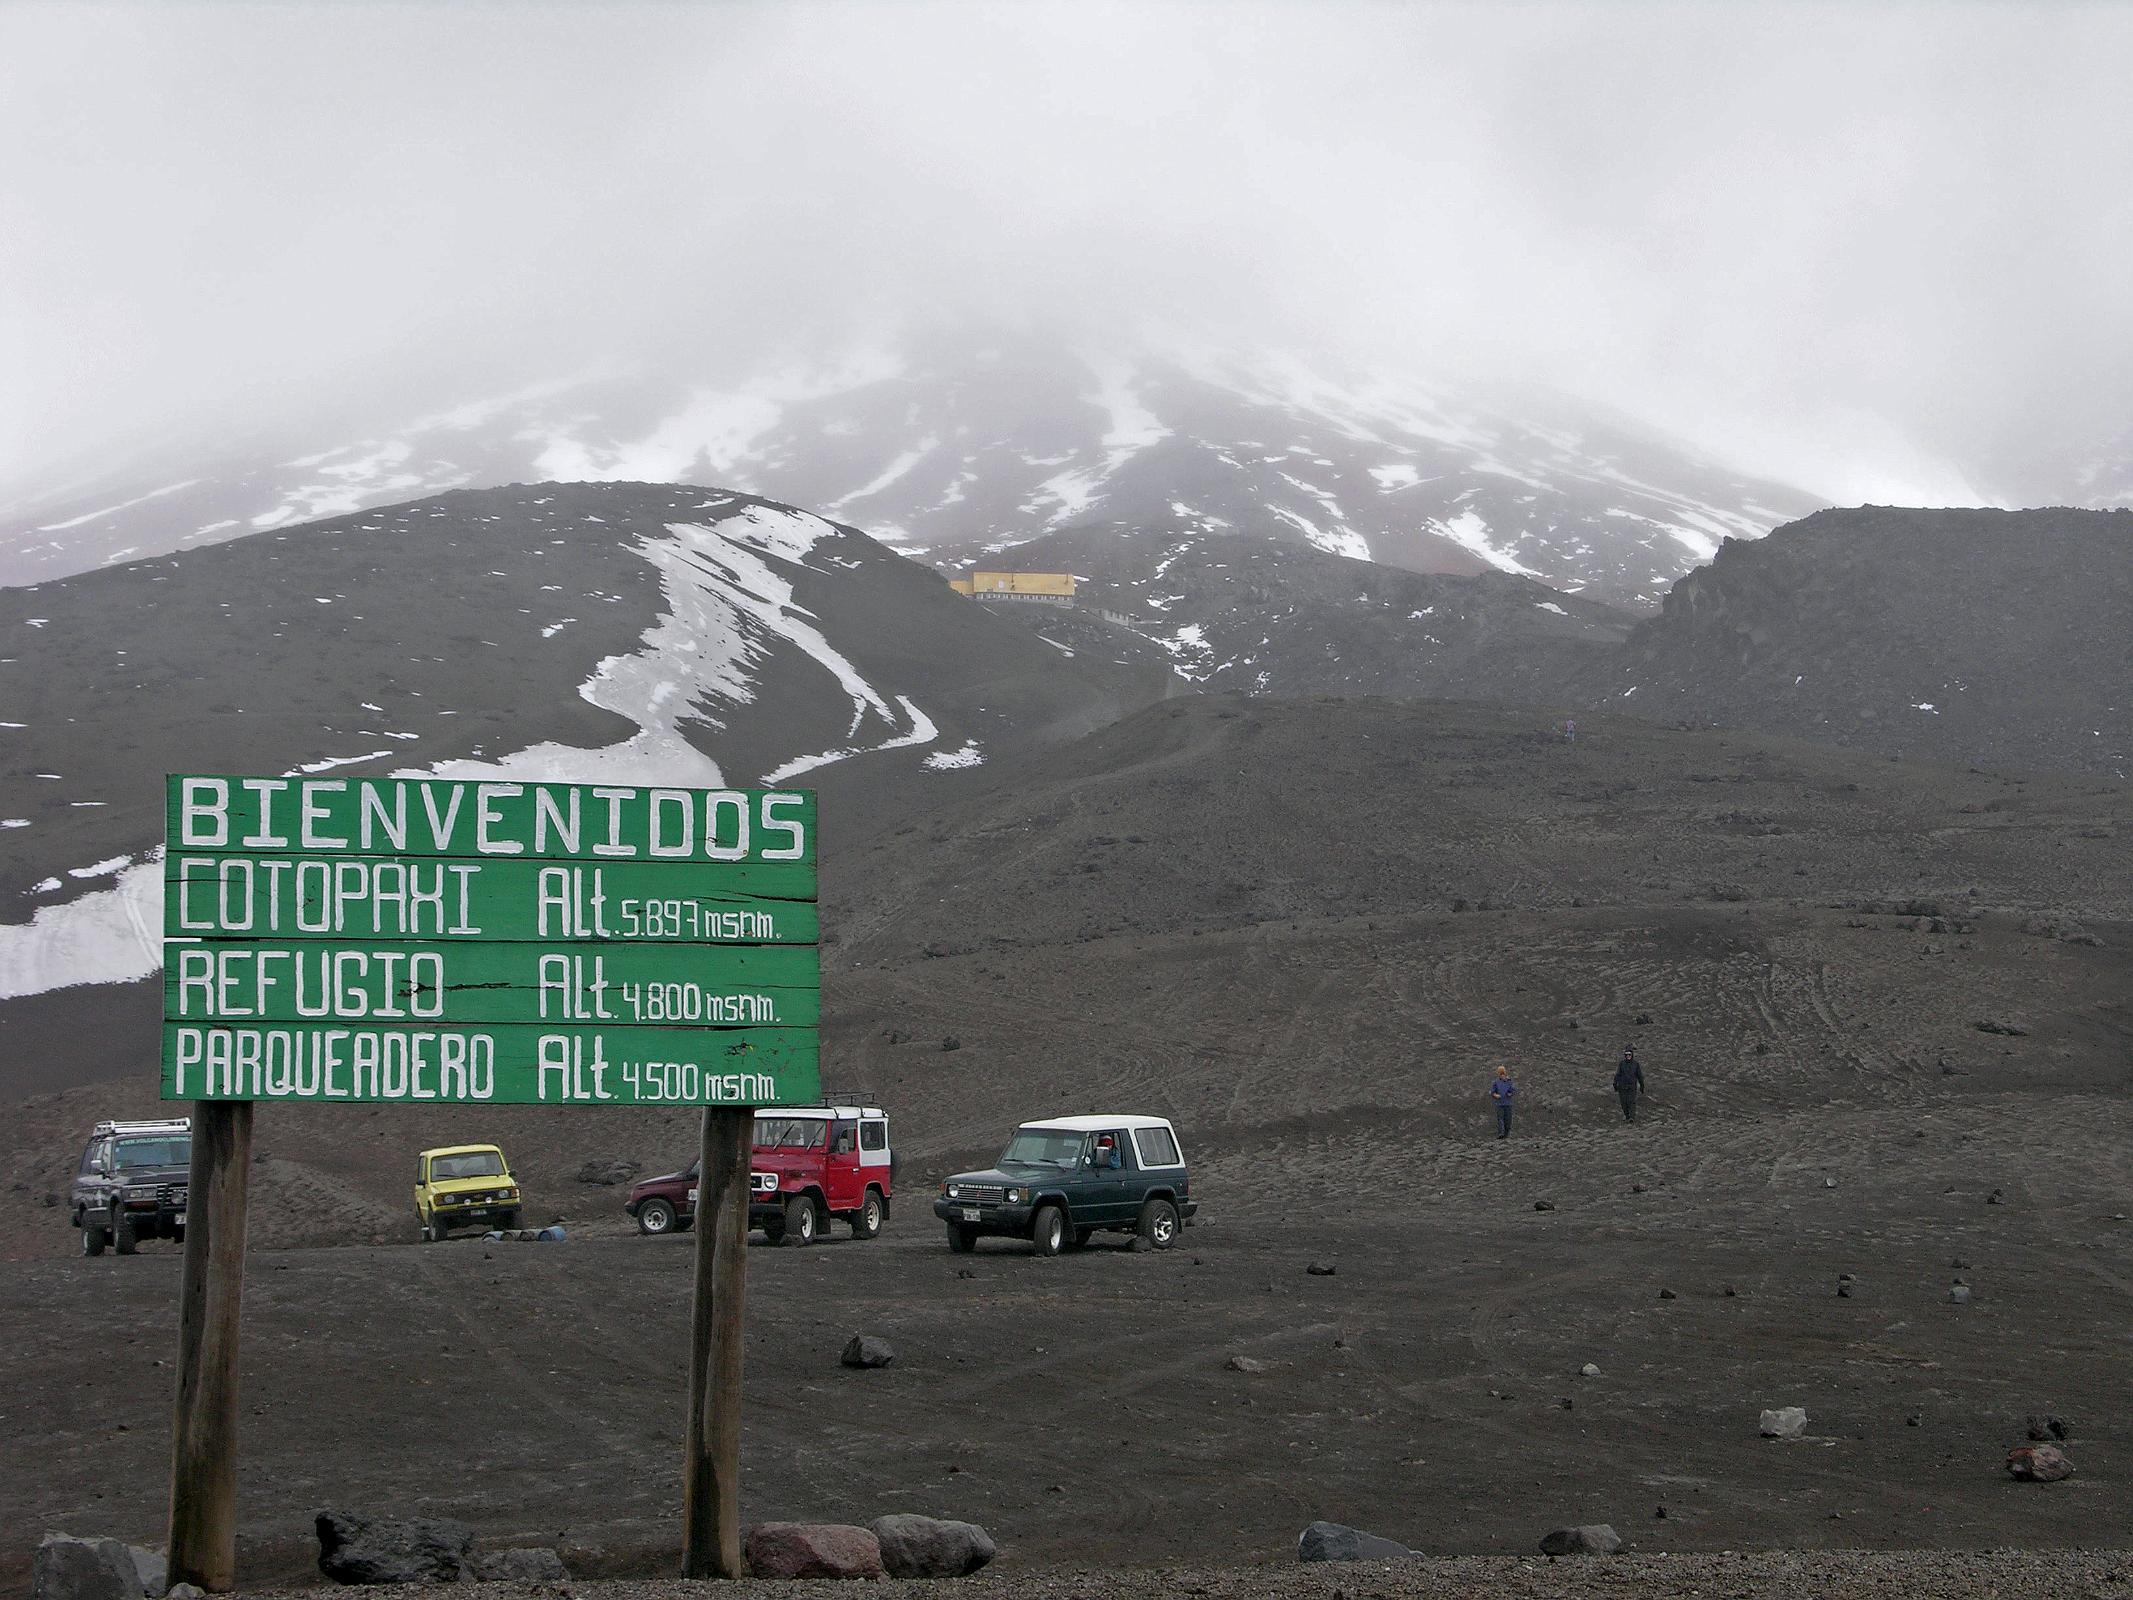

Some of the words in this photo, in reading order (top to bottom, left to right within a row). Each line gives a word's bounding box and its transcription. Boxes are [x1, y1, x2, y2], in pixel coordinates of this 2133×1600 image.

[181, 777, 805, 861] BIENVENIDOS
[179, 857, 482, 935] COTOPAXI
[621, 899, 700, 937] 5.897
[704, 910, 782, 939] msnm.
[179, 949, 444, 1018] REFUGIO
[622, 981, 702, 1022] 4.800
[705, 992, 782, 1023] msnm.
[175, 1027, 494, 1099] PARQUEADERO
[622, 1061, 699, 1101] 4.500
[704, 1072, 781, 1101] msnm.
